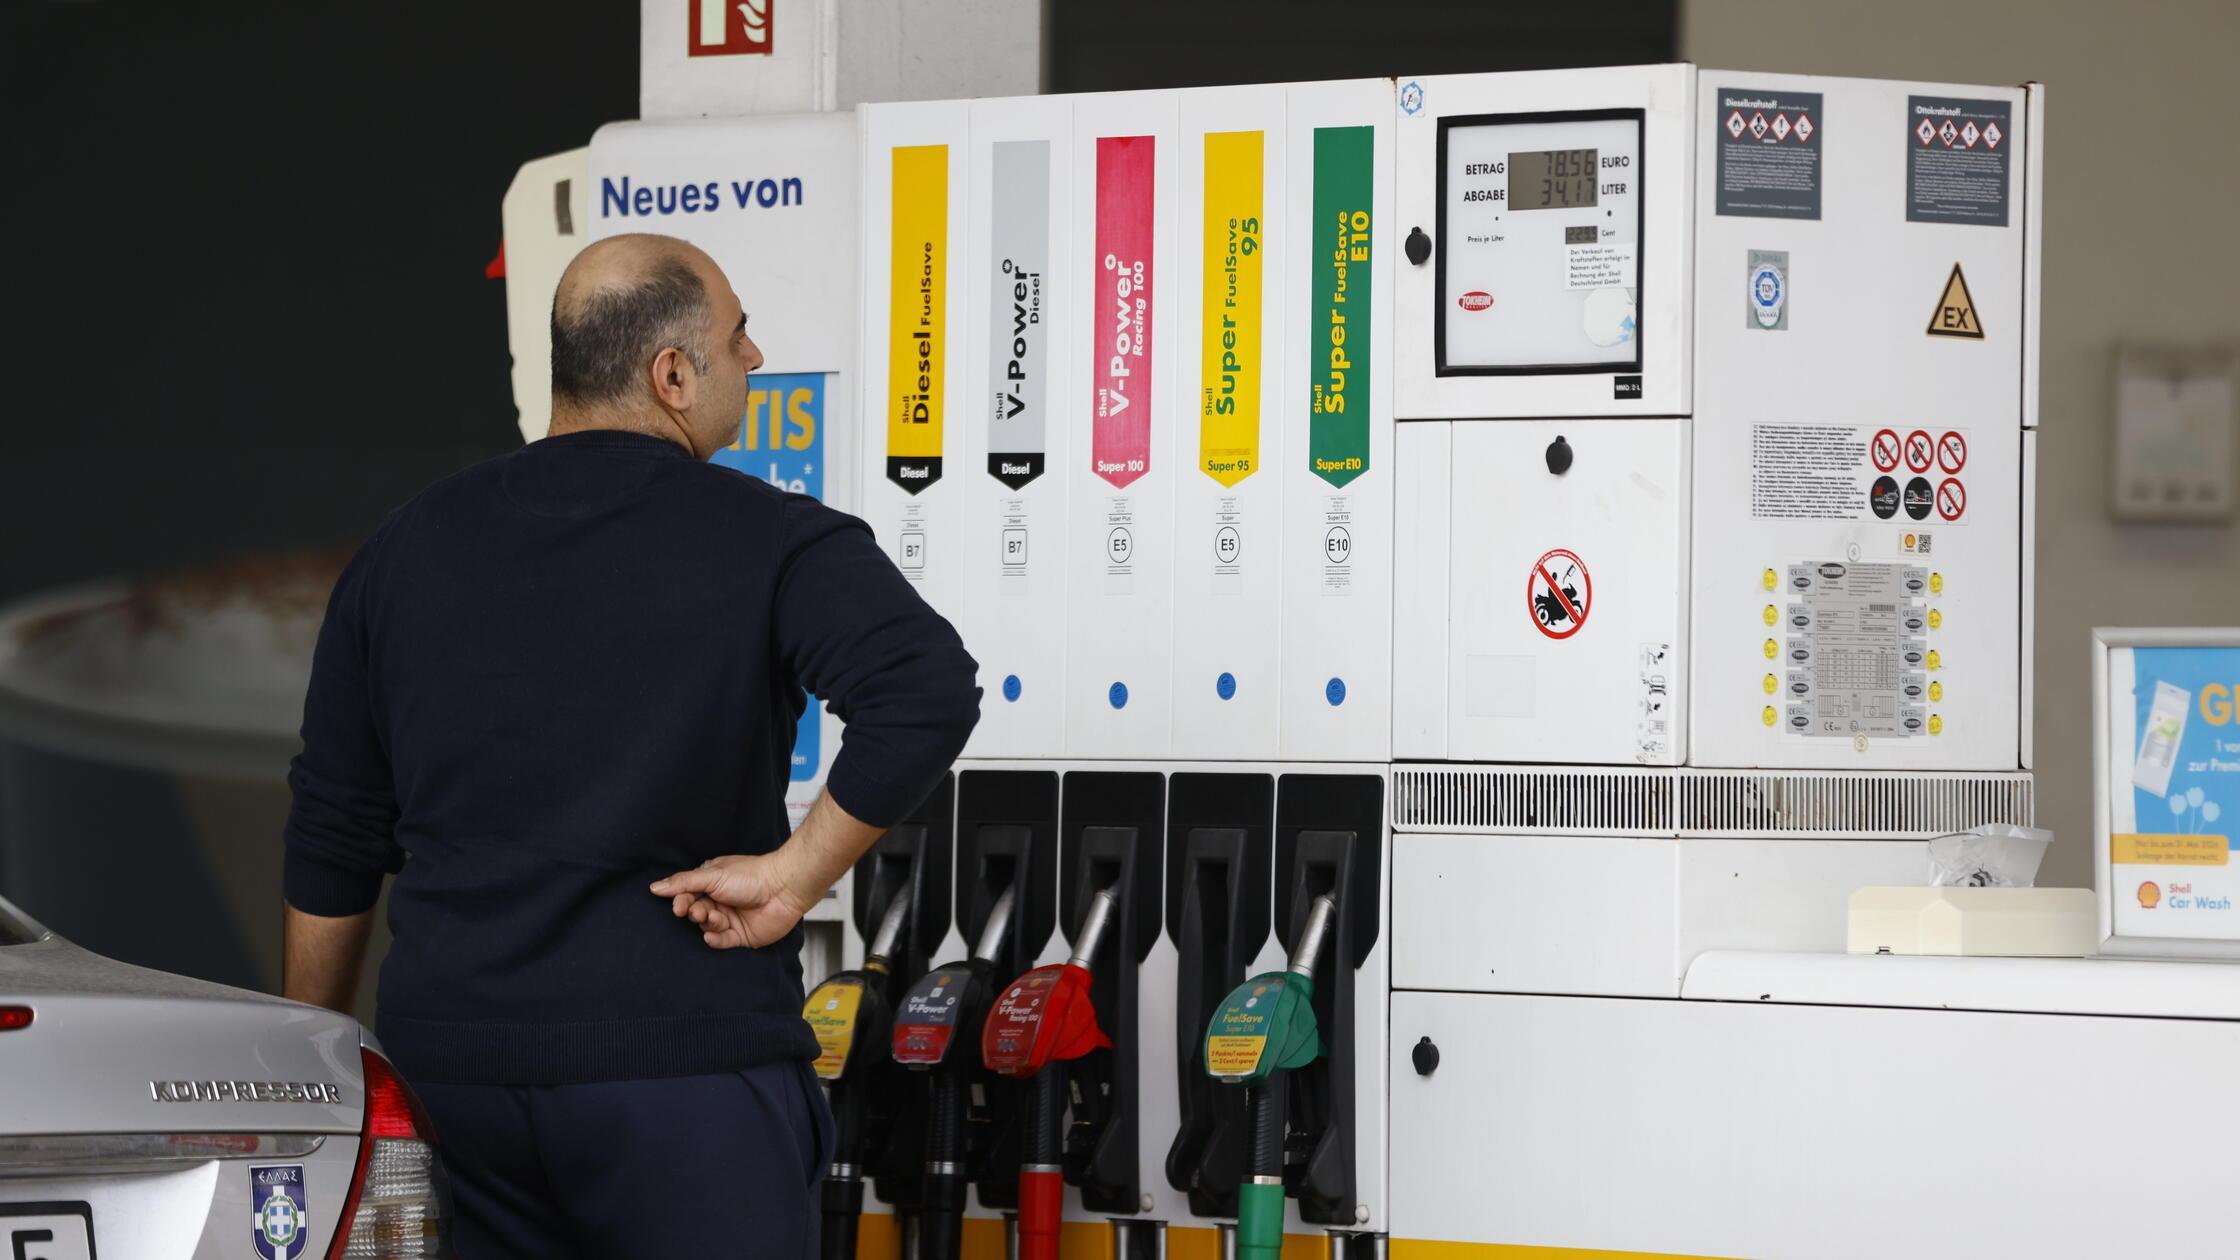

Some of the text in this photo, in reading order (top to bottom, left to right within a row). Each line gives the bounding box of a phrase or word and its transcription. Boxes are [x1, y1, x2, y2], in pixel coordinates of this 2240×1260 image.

[1725, 98, 1778, 109] Dieselkraftstoff
[1915, 105, 1962, 117] Ottokraftstoff
[1466, 162, 1505, 176] BETRAG
[1601, 155, 1630, 168] EURO
[602, 176, 803, 218] Neues von
[1464, 189, 1505, 202] ABGABE
[1601, 183, 1627, 195] LITER
[1241, 217, 1259, 256] 95
[1351, 210, 1370, 262] E10
[1467, 235, 1482, 243] Preis
[1484, 236, 1490, 244] je
[1491, 234, 1505, 242] Liter
[1030, 272, 1040, 324] Diesel
[1132, 260, 1146, 356] Racing 100
[1215, 217, 1241, 416] Super FuelSave
[1325, 211, 1351, 414] Super FuelSave
[1943, 306, 1969, 329] EX
[912, 241, 933, 424] Diesel FuelSave
[1109, 260, 1132, 417] V-Power
[1006, 265, 1028, 420] V-Power
[996, 392, 1004, 420] Shell
[1099, 388, 1107, 417] Shell
[1205, 387, 1213, 416] Shell
[1314, 384, 1322, 414] Shell
[901, 395, 911, 423] Shell
[728, 387, 816, 451] TIS
[899, 465, 929, 479] Diesel
[1001, 462, 1030, 475] Diesel
[1097, 459, 1144, 473] Super 100
[1207, 460, 1249, 473] Super 95
[1316, 457, 1362, 472] Super E10
[1327, 514, 1340, 522] Super
[906, 545, 920, 557] B7
[1008, 541, 1022, 554] B7
[1113, 538, 1127, 552] E5
[1221, 538, 1235, 552] E5
[1328, 538, 1349, 551] E10
[2199, 683, 2240, 726] G
[2188, 761, 2208, 772] zur
[2168, 883, 2192, 894] Shell
[2168, 896, 2231, 910] Car Wash
[908, 1003, 949, 1014] V-Power
[910, 996, 928, 1004] Shell
[999, 1006, 1033, 1015] V-Power
[1222, 1014, 1264, 1023] FuelSave
[148, 1080, 342, 1104] KOMPRESSOR
